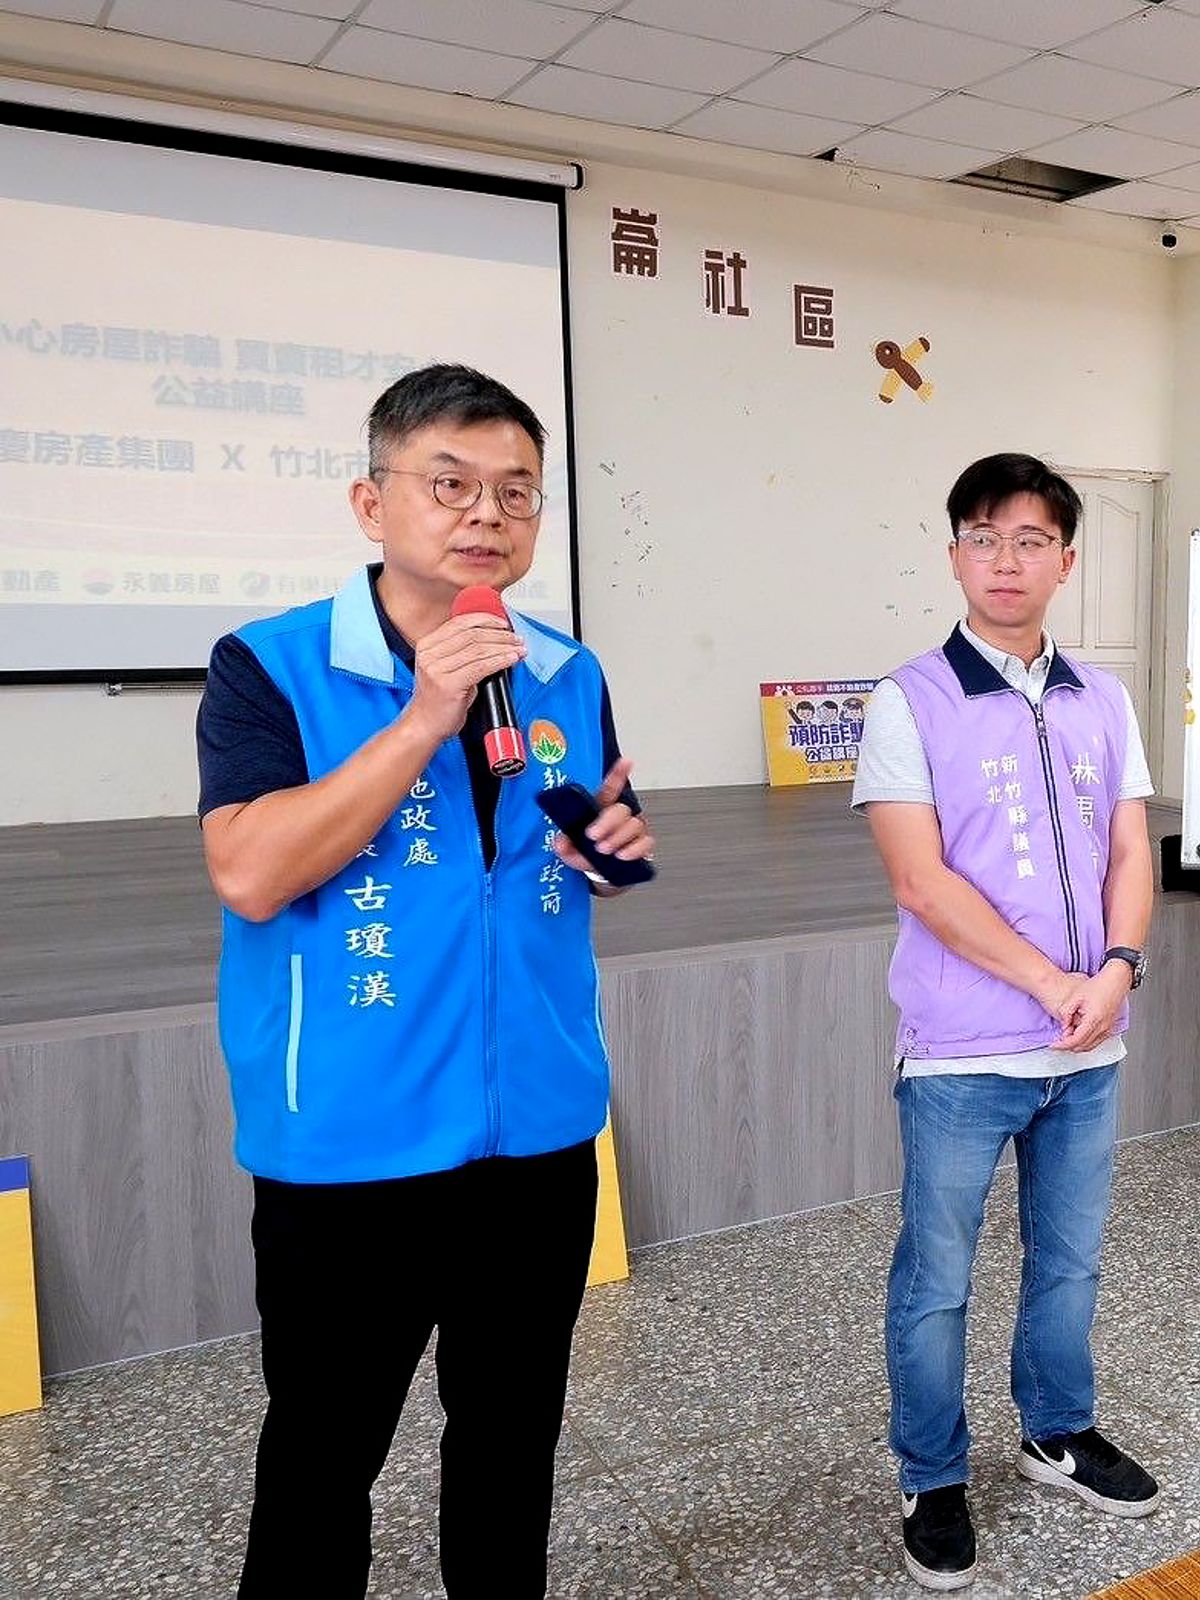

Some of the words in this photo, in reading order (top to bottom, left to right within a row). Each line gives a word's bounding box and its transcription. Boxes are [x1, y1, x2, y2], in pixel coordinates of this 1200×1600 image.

[0, 319, 221, 369] 心房屋詐騙
[153, 374, 305, 415] 公益講座
[345, 877, 397, 1008] 古瓊漢
